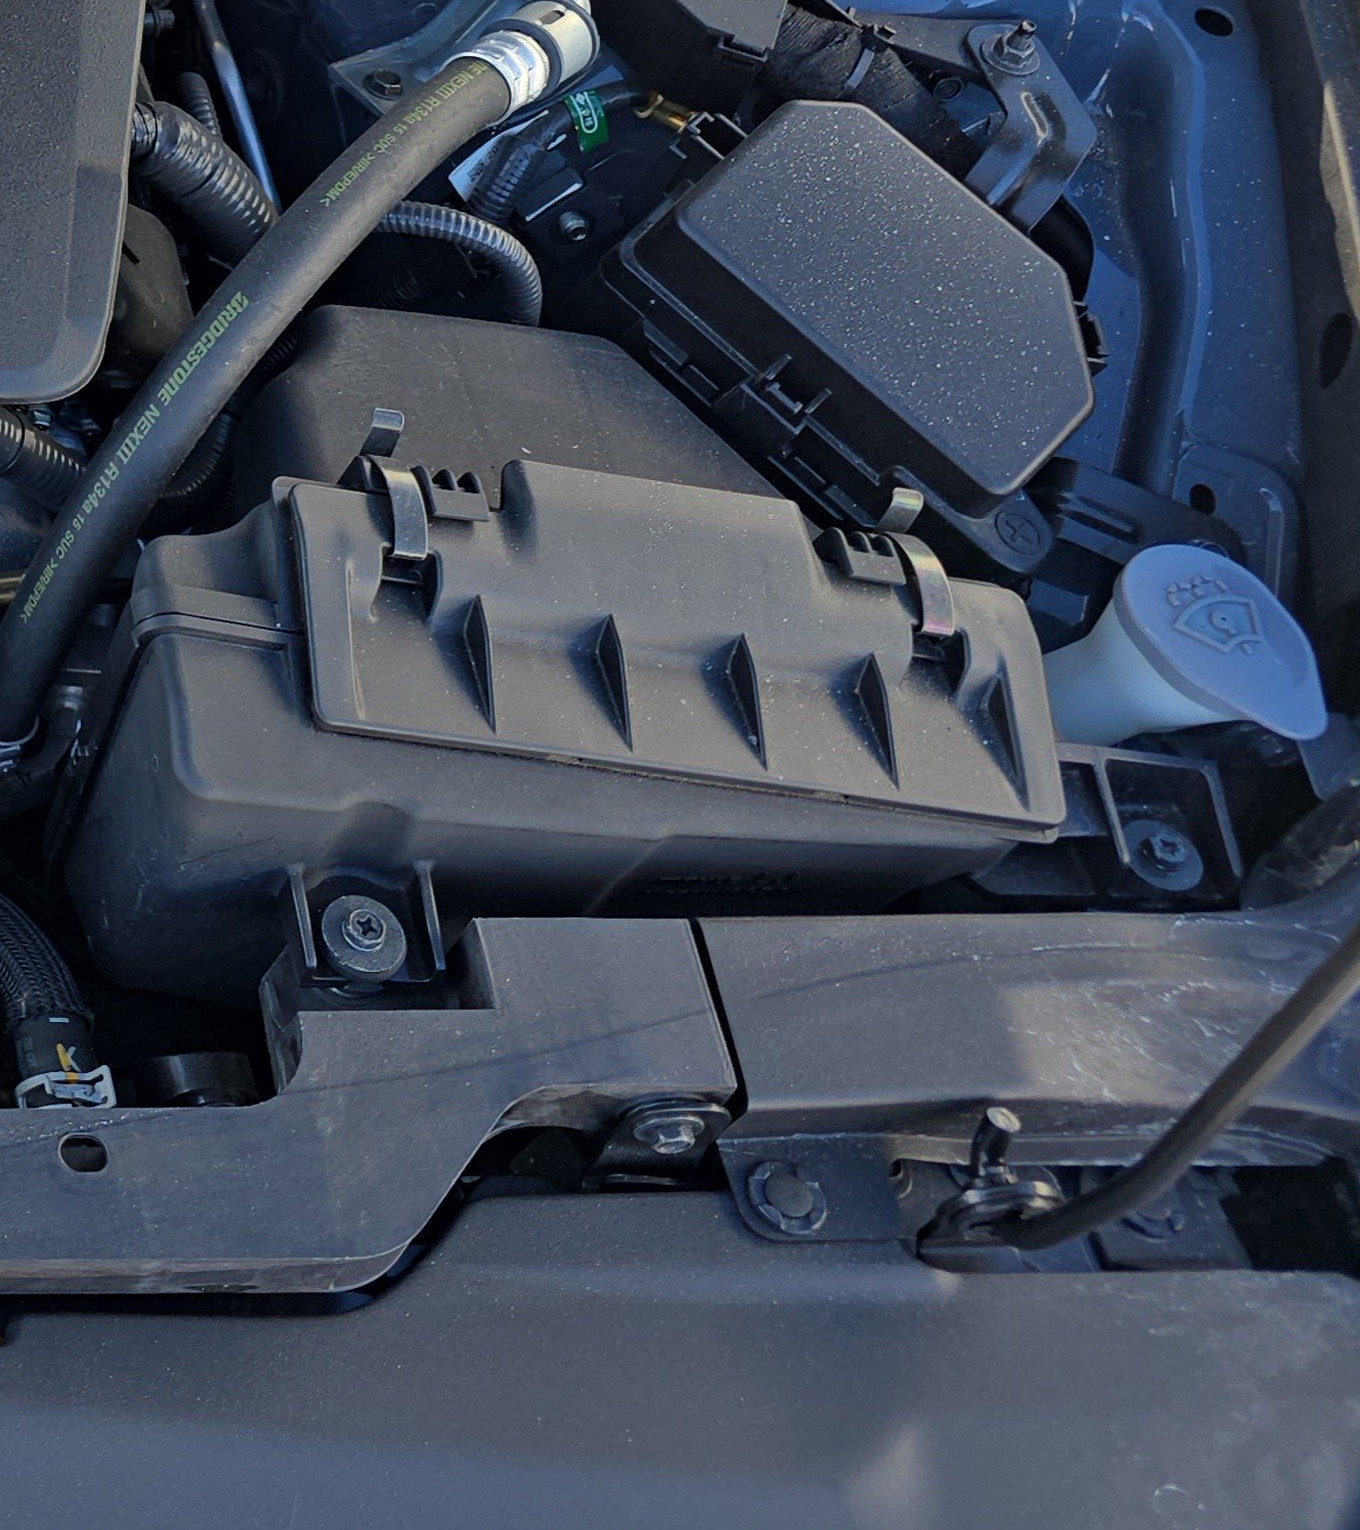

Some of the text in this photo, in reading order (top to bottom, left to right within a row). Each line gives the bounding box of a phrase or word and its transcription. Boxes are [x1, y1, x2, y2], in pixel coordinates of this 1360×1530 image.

[373, 134, 397, 154] SUC
[157, 291, 250, 406] BRIDGESTONE
[56, 530, 75, 560] SUC
